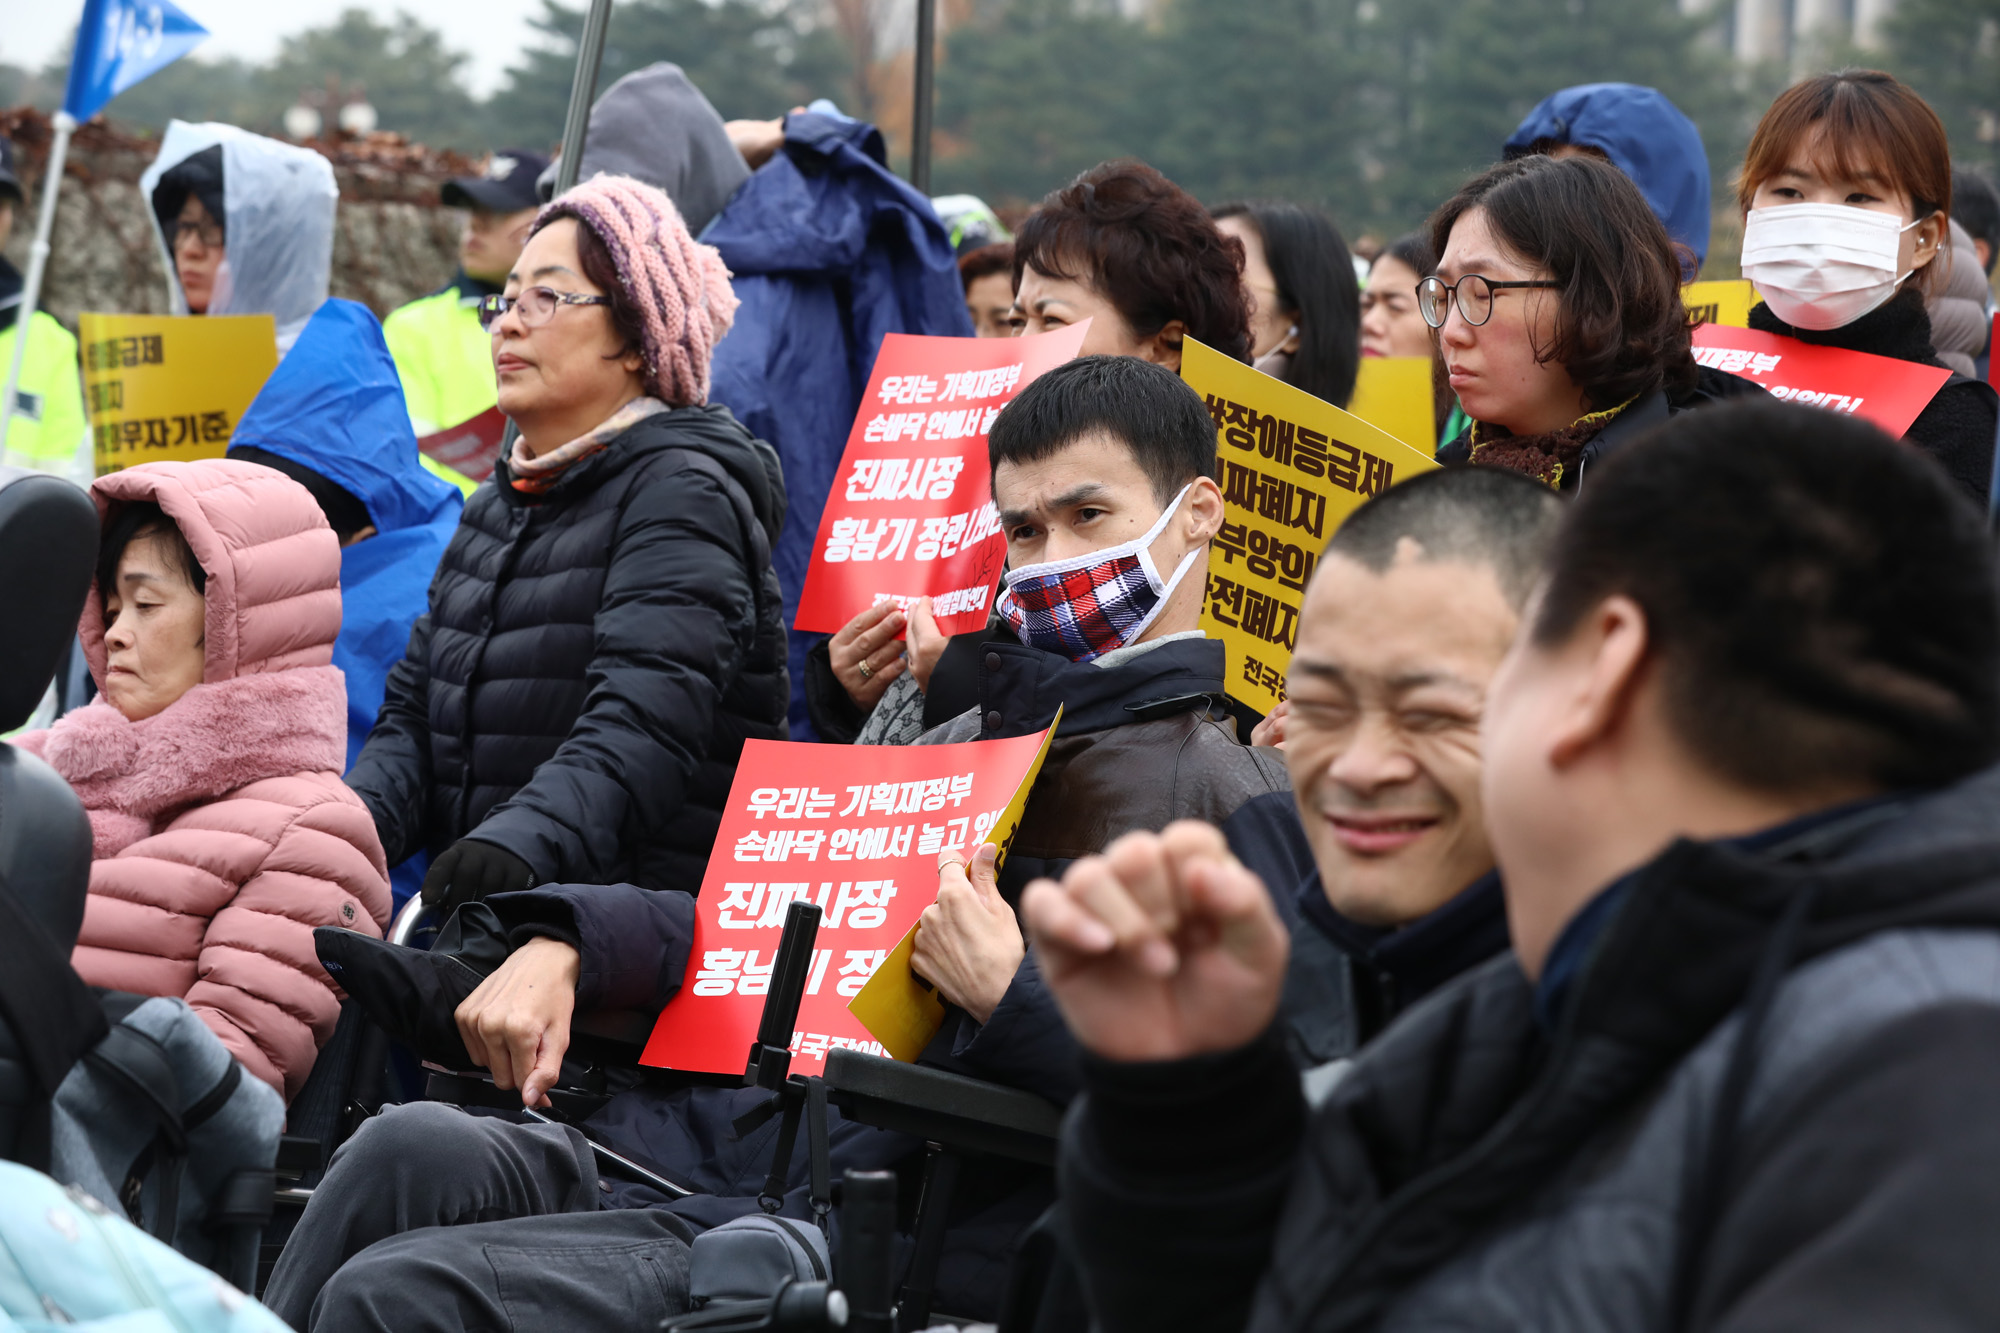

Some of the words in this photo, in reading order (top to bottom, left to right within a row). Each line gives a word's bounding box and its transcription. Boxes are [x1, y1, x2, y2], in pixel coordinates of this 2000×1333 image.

[878, 376, 938, 405] 우리는
[937, 362, 1024, 402] 기획재정부
[863, 412, 927, 443] 손바닥
[924, 407, 983, 441] 안에서
[979, 401, 1012, 436] 놀
[845, 456, 964, 501] 진짜사장
[824, 517, 917, 562] 홍남기
[914, 512, 969, 561] 장관
[1213, 518, 1322, 594] 부양의
[1200, 572, 1301, 654] 전폐지
[746, 788, 836, 819] 우리는
[839, 772, 974, 817] 기획재정부
[733, 829, 826, 862] 손바닥
[827, 825, 915, 861] 안에서
[917, 816, 969, 856] 놀고
